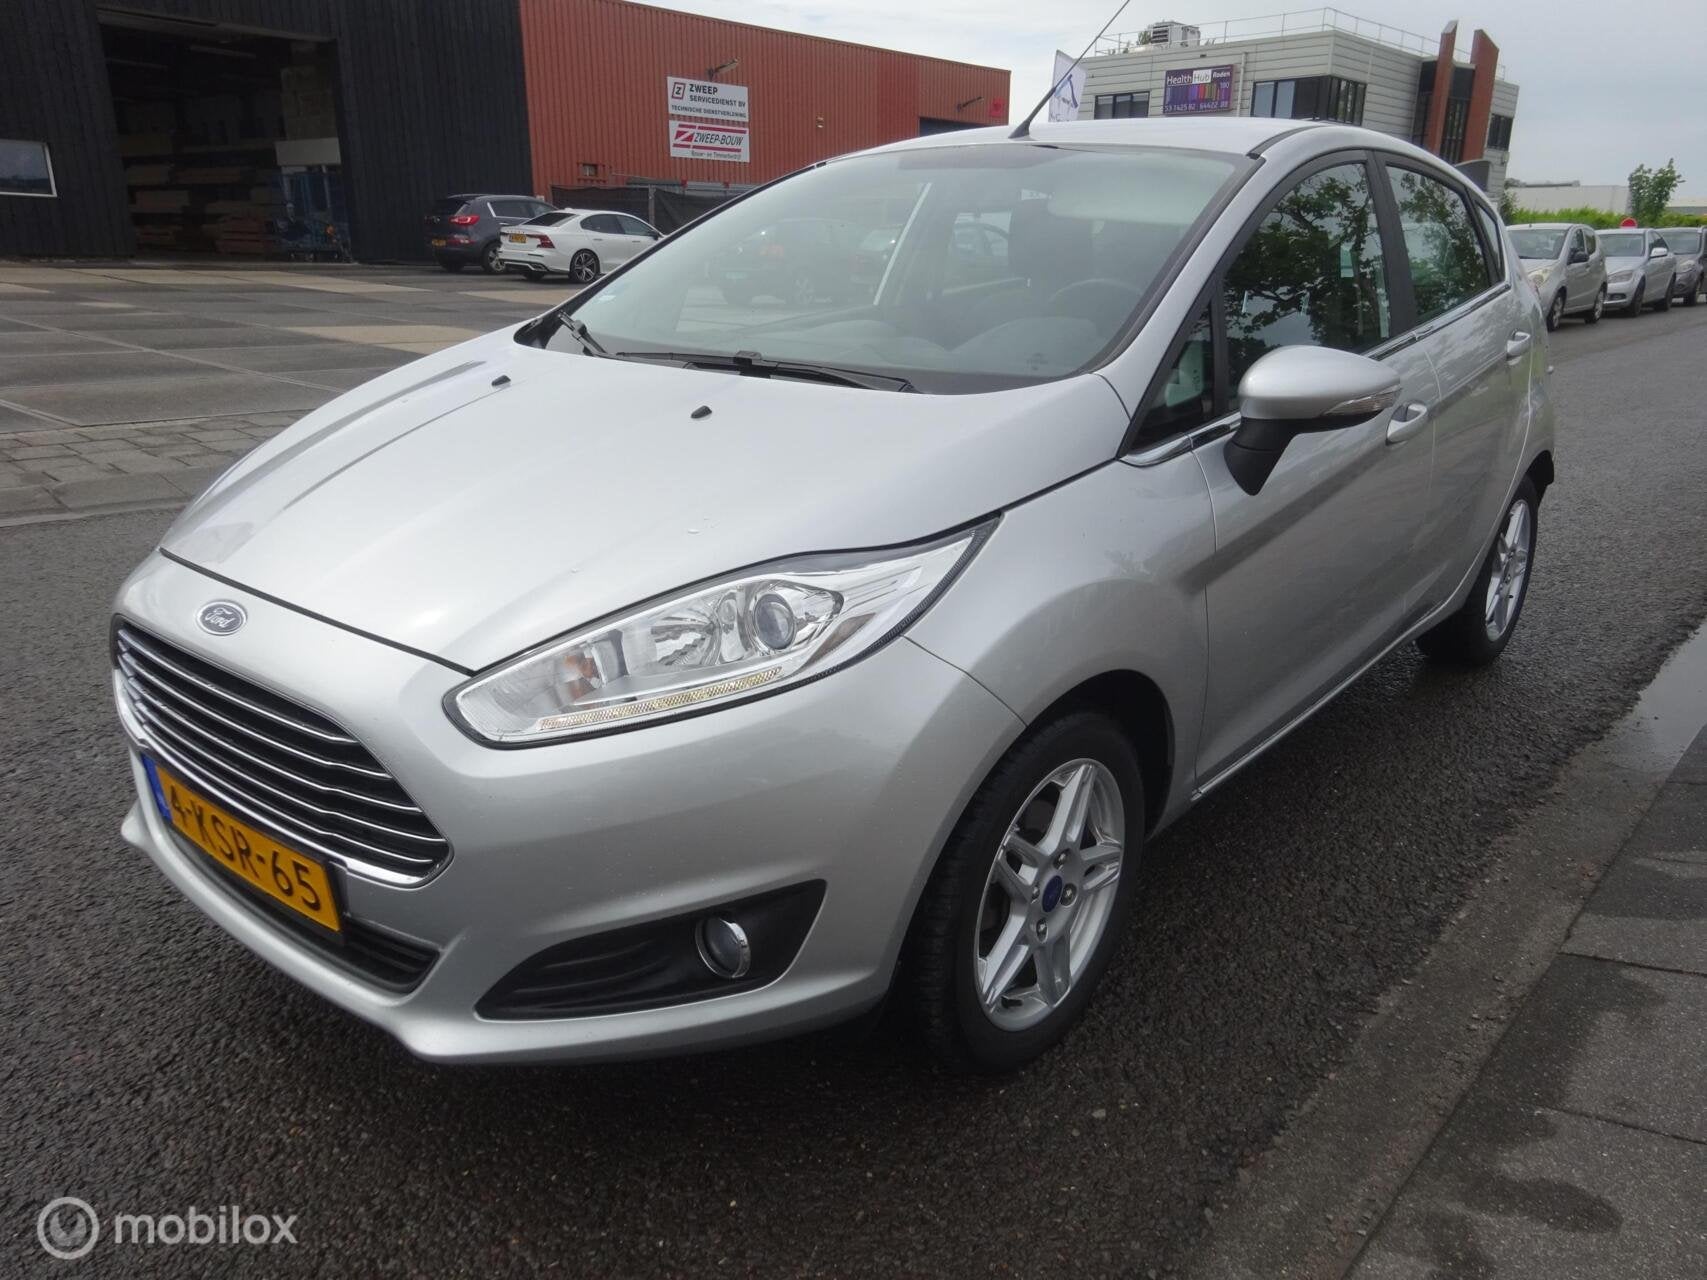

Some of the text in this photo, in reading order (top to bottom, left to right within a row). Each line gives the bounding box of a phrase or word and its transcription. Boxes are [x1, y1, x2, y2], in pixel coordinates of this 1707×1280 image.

[1167, 70, 1210, 85] Health Hub
[689, 84, 718, 95] ZWEEP
[689, 95, 737, 106] SERVICEDIENST
[671, 104, 702, 113] TECHNISCHE
[693, 132, 744, 146] ZWEEP-BOUW
[204, 607, 236, 628] Ford
[170, 785, 321, 912] 4-KSR-65
